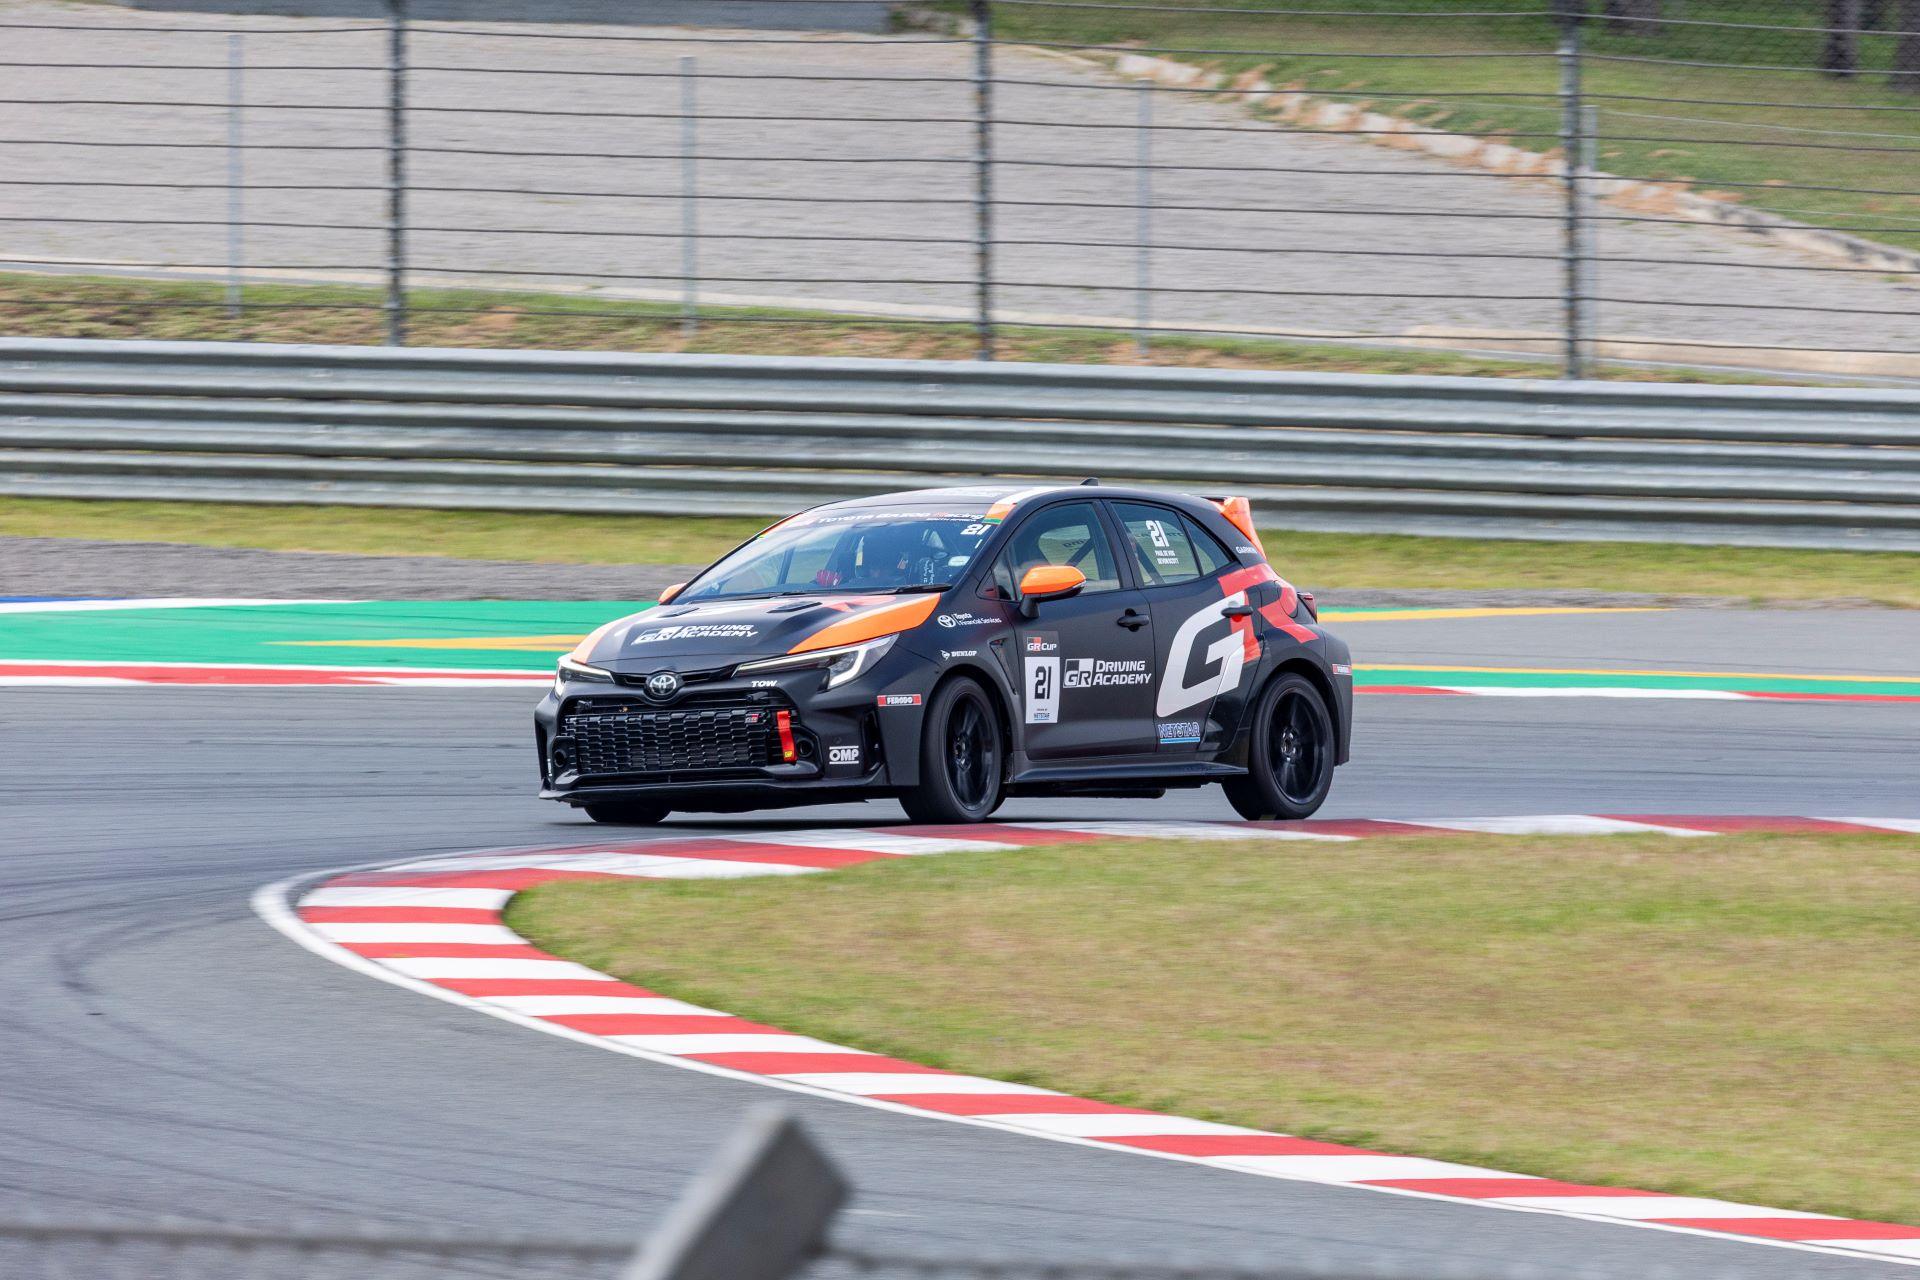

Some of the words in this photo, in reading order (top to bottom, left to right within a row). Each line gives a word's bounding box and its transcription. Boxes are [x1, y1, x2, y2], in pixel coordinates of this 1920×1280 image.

[1146, 520, 1170, 547] 21
[672, 631, 759, 639] ACADEMY
[1027, 642, 1041, 651] GR
[1096, 661, 1146, 672] DRIVING
[1034, 666, 1052, 699] 21
[1063, 667, 1093, 688] GR
[1092, 673, 1152, 685] ACADEMY
[751, 680, 777, 688] TOW
[886, 696, 913, 705] FERODO
[1157, 721, 1200, 738] NETSTAR
[829, 749, 859, 761] OMP
